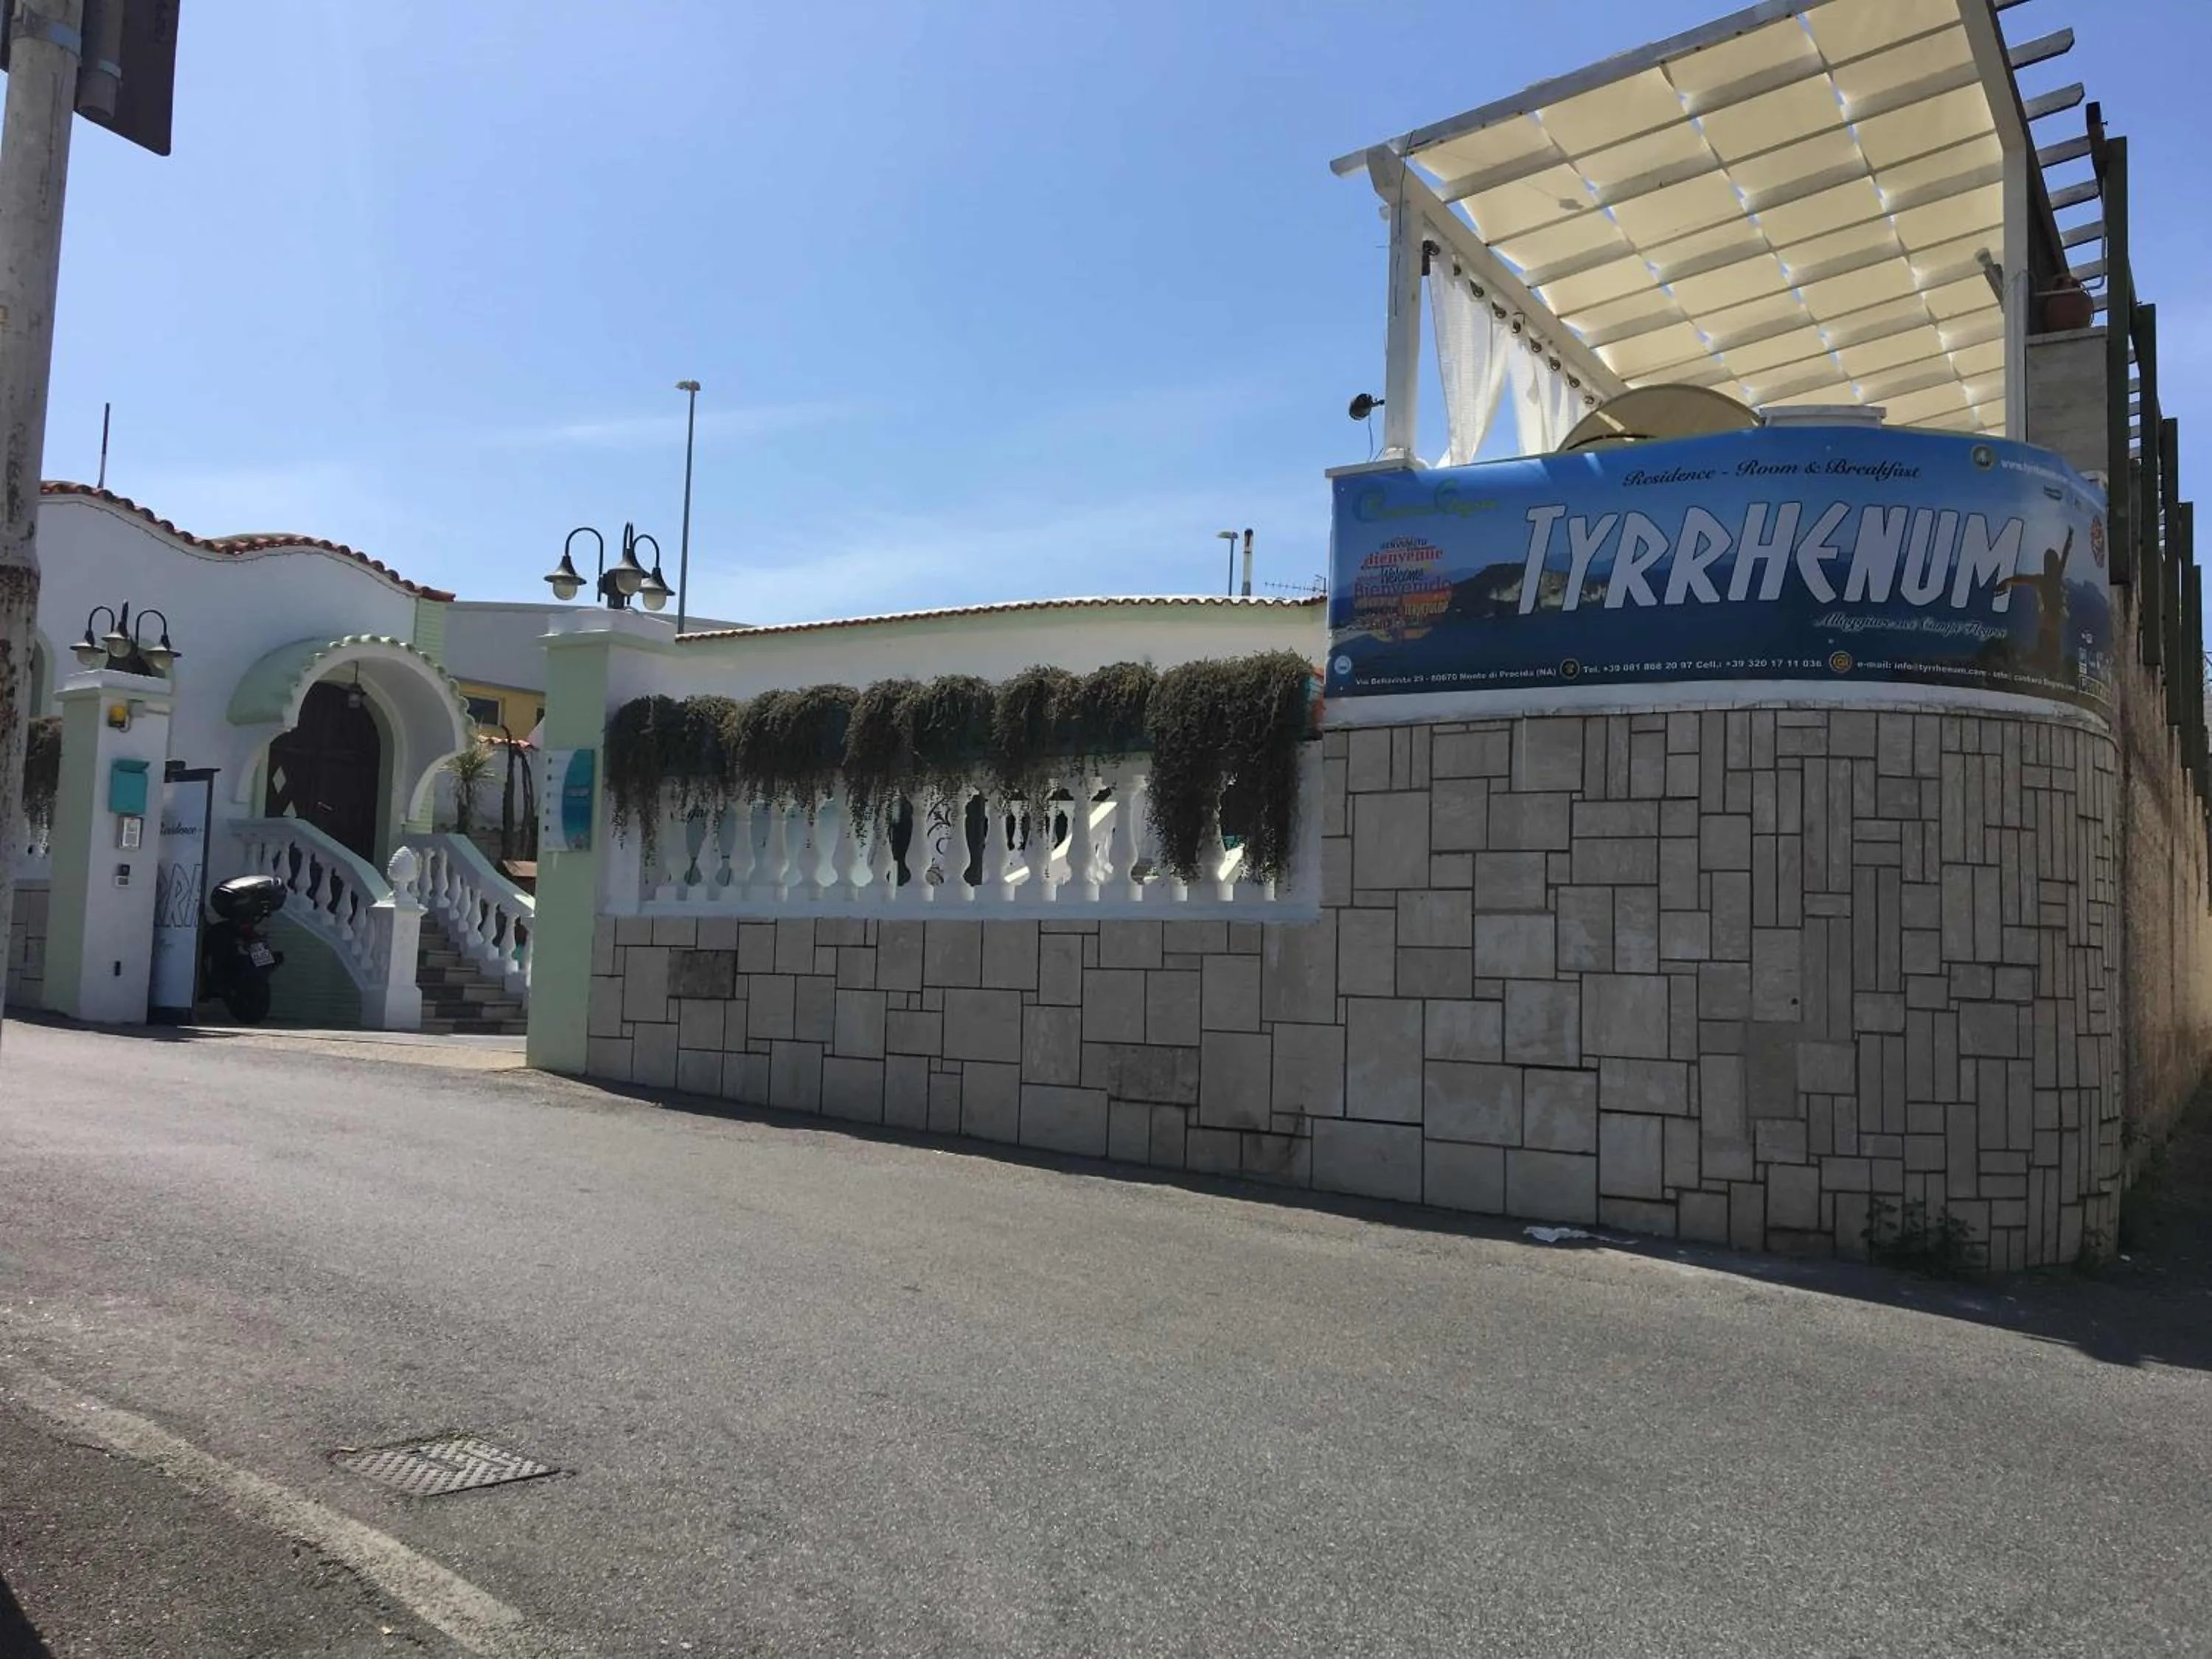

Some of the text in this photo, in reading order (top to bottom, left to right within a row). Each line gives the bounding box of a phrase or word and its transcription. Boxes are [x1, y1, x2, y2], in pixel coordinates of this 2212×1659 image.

[1623, 467, 1716, 487] Residence
[1735, 459, 1798, 477] Room
[1804, 463, 1820, 474] &
[1826, 458, 1920, 481] Breakfast
[1518, 500, 2026, 616] TYRRHENUM
[1536, 667, 1557, 678] (NA)
[1747, 659, 1767, 667] 320
[1771, 659, 1784, 667] 17
[1787, 659, 1798, 667] 11
